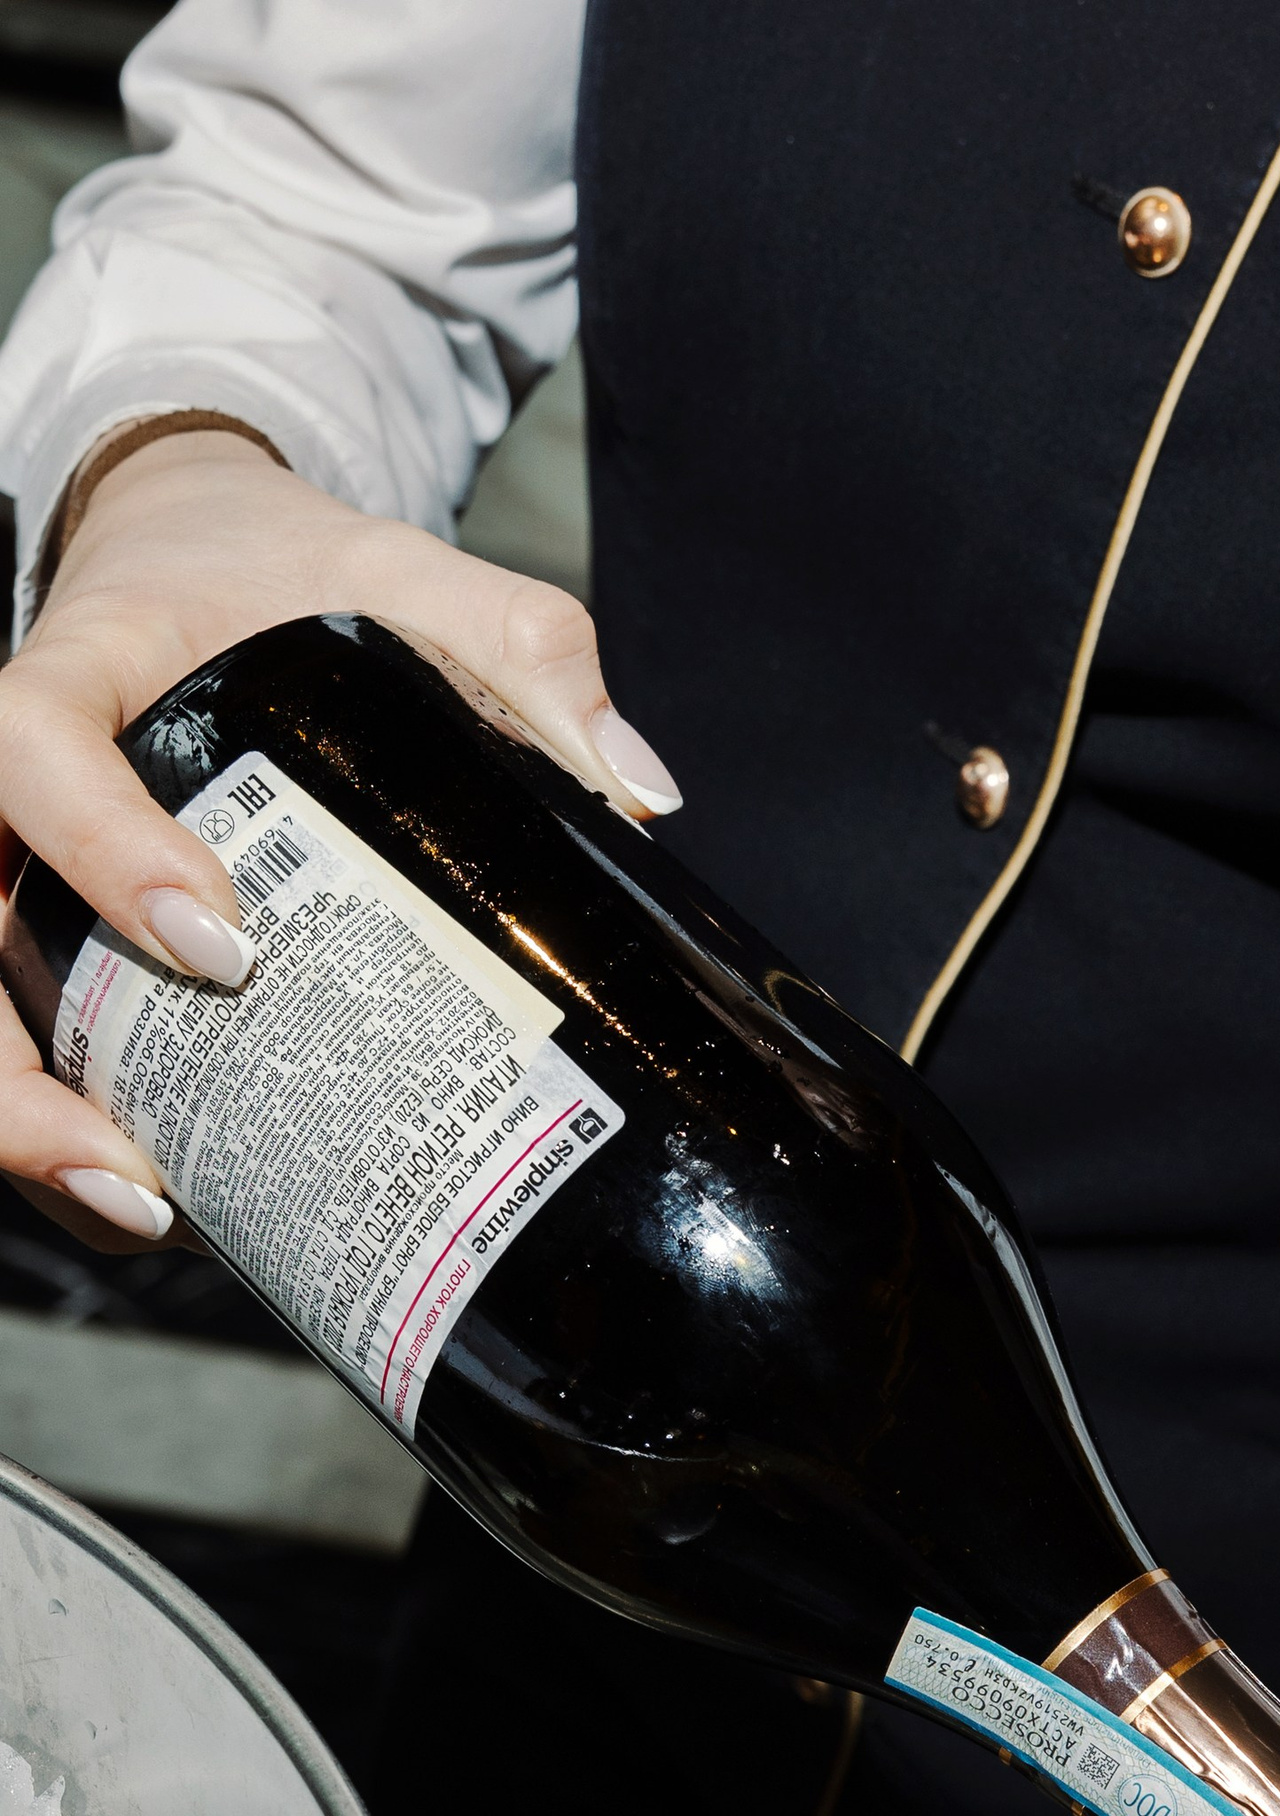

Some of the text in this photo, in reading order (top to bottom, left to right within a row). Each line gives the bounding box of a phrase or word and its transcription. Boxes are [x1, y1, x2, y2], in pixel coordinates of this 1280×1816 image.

[280, 813, 295, 827] 4
[330, 892, 363, 923] СРОК
[283, 914, 338, 969] ГОДНОСТИ
[334, 908, 396, 967] Генеральный
[369, 928, 415, 972] Импортер
[413, 941, 429, 956] до
[152, 964, 176, 998] ата
[273, 962, 292, 983] НЕ
[336, 963, 352, 980] 4-я
[364, 935, 422, 991] центральной
[383, 948, 435, 997] превышает
[399, 958, 412, 971] 18
[435, 963, 449, 976] не
[230, 975, 281, 1037] ОГРАНИЧЕН
[328, 989, 366, 1029] нервной
[335, 980, 348, 994] на
[398, 968, 456, 1022] температуре
[409, 974, 438, 1001] более
[411, 981, 470, 1037] воздействия
[152, 885, 337, 1172] ЧРЕЗМЕРНОЕ УПОТРЕБЛЕНИЕ АЛКОГОЛЯ
[289, 991, 337, 1046] территории
[322, 992, 375, 1051] беременным
[388, 1021, 401, 1034] от
[434, 996, 483, 1043] Вичентино
[463, 1016, 476, 1028] IV
[472, 1002, 490, 1019] Via
[117, 995, 157, 1074] розлива:
[138, 973, 222, 1123] АШЕМУ ЗДОРОВЬЮ.
[217, 1029, 238, 1057] ПРИ
[235, 1042, 247, 1058] +7
[261, 1029, 281, 1054] ООО
[346, 1023, 385, 1066] Пищевая
[375, 1035, 412, 1075] прямого
[398, 1025, 437, 1065] Хранить
[446, 1009, 504, 1064] ДИОКСИД
[465, 1024, 517, 1074] СОСТАВ:
[63, 1023, 91, 1100] simple
[185, 1047, 226, 1119] СОБЛЮДЕНИИ
[221, 1054, 239, 1080] (495)
[229, 1054, 250, 1083] округ
[230, 1051, 265, 1104] КОМПАНИЯ
[260, 1064, 278, 1089] ООО
[265, 982, 414, 1170] 68 285 Содержание вредных
[354, 1038, 397, 1087] влажности
[418, 1058, 454, 1095] СЕРЫ
[213, 1077, 226, 1096] 510
[246, 1069, 285, 1127] организация
[276, 1063, 313, 1112] кормящим
[334, 1074, 377, 1128] солнечного
[344, 1085, 356, 1099] не
[371, 1083, 409, 1127] Montorso
[429, 1074, 465, 1111] ВИНО
[452, 1053, 527, 1127] ИТАЛИЯ.
[255, 1101, 276, 1133] печени
[277, 1087, 308, 1132] Алкоголь
[293, 1097, 334, 1157] герметичной
[323, 1098, 346, 1128] более
[409, 1111, 430, 1133] ИЗ
[497, 1093, 539, 1135] ВИНО
[272, 1133, 298, 1177] ценность
[293, 1148, 312, 1178] После
[316, 1128, 336, 1156] света
[323, 1143, 338, 1163] без
[342, 1123, 375, 1166] Vicentino
[375, 1133, 411, 1177] СОРТА
[401, 1113, 466, 1186] РЕГИОН
[440, 1126, 505, 1198] ИГРИСТОЕ
[303, 1154, 318, 1175] при
[330, 1122, 395, 1215] ИЗГОТОВИТЕЛЬ:
[332, 1161, 347, 1181] (VI)
[434, 1148, 463, 1182] Место
[316, 1176, 338, 1209] (36050
[332, 1174, 379, 1246] ВИНОГРАДА
[361, 1172, 417, 1249] ВЕНЕТО.
[410, 1189, 450, 1240] БЕЛОЕ
[470, 1138, 575, 1257] simplewine
[381, 1177, 437, 1256] происхождения
[342, 1232, 377, 1279] ГОД
[388, 1231, 420, 1276] БРЮТ
[431, 1254, 471, 1310] ГЛОТОК
[404, 1301, 441, 1373] ХОРОШЕГО
[912, 1632, 960, 1661] 0.750
[921, 1653, 1077, 1751] ACTX09099534
[948, 1682, 1071, 1767] PROSECCO
